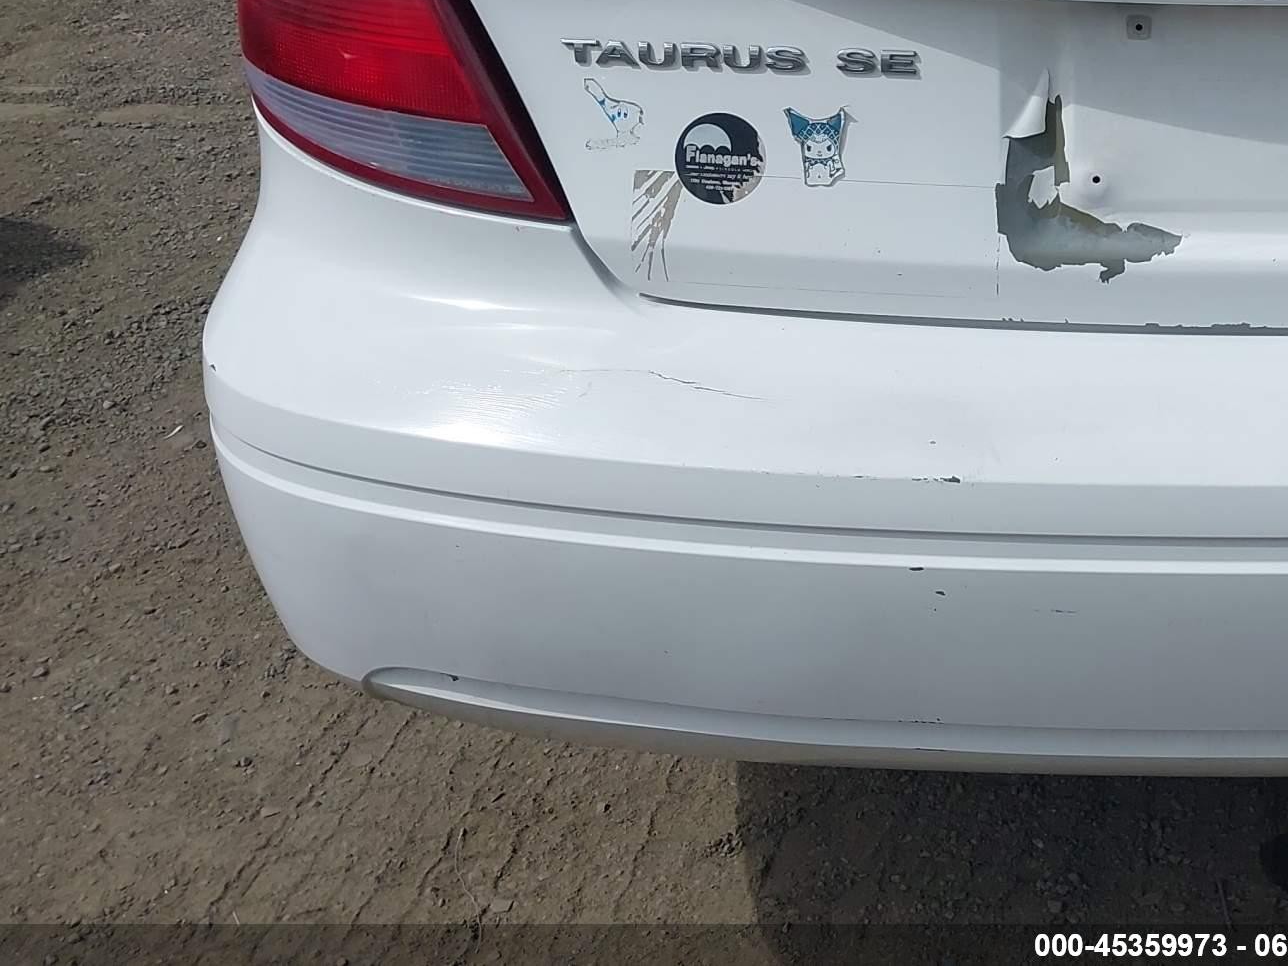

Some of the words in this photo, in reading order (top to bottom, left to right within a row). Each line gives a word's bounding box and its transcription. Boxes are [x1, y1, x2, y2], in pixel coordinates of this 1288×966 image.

[560, 37, 808, 73] TAURUS
[836, 47, 917, 76] SE
[685, 145, 760, 168] Flanagan's
